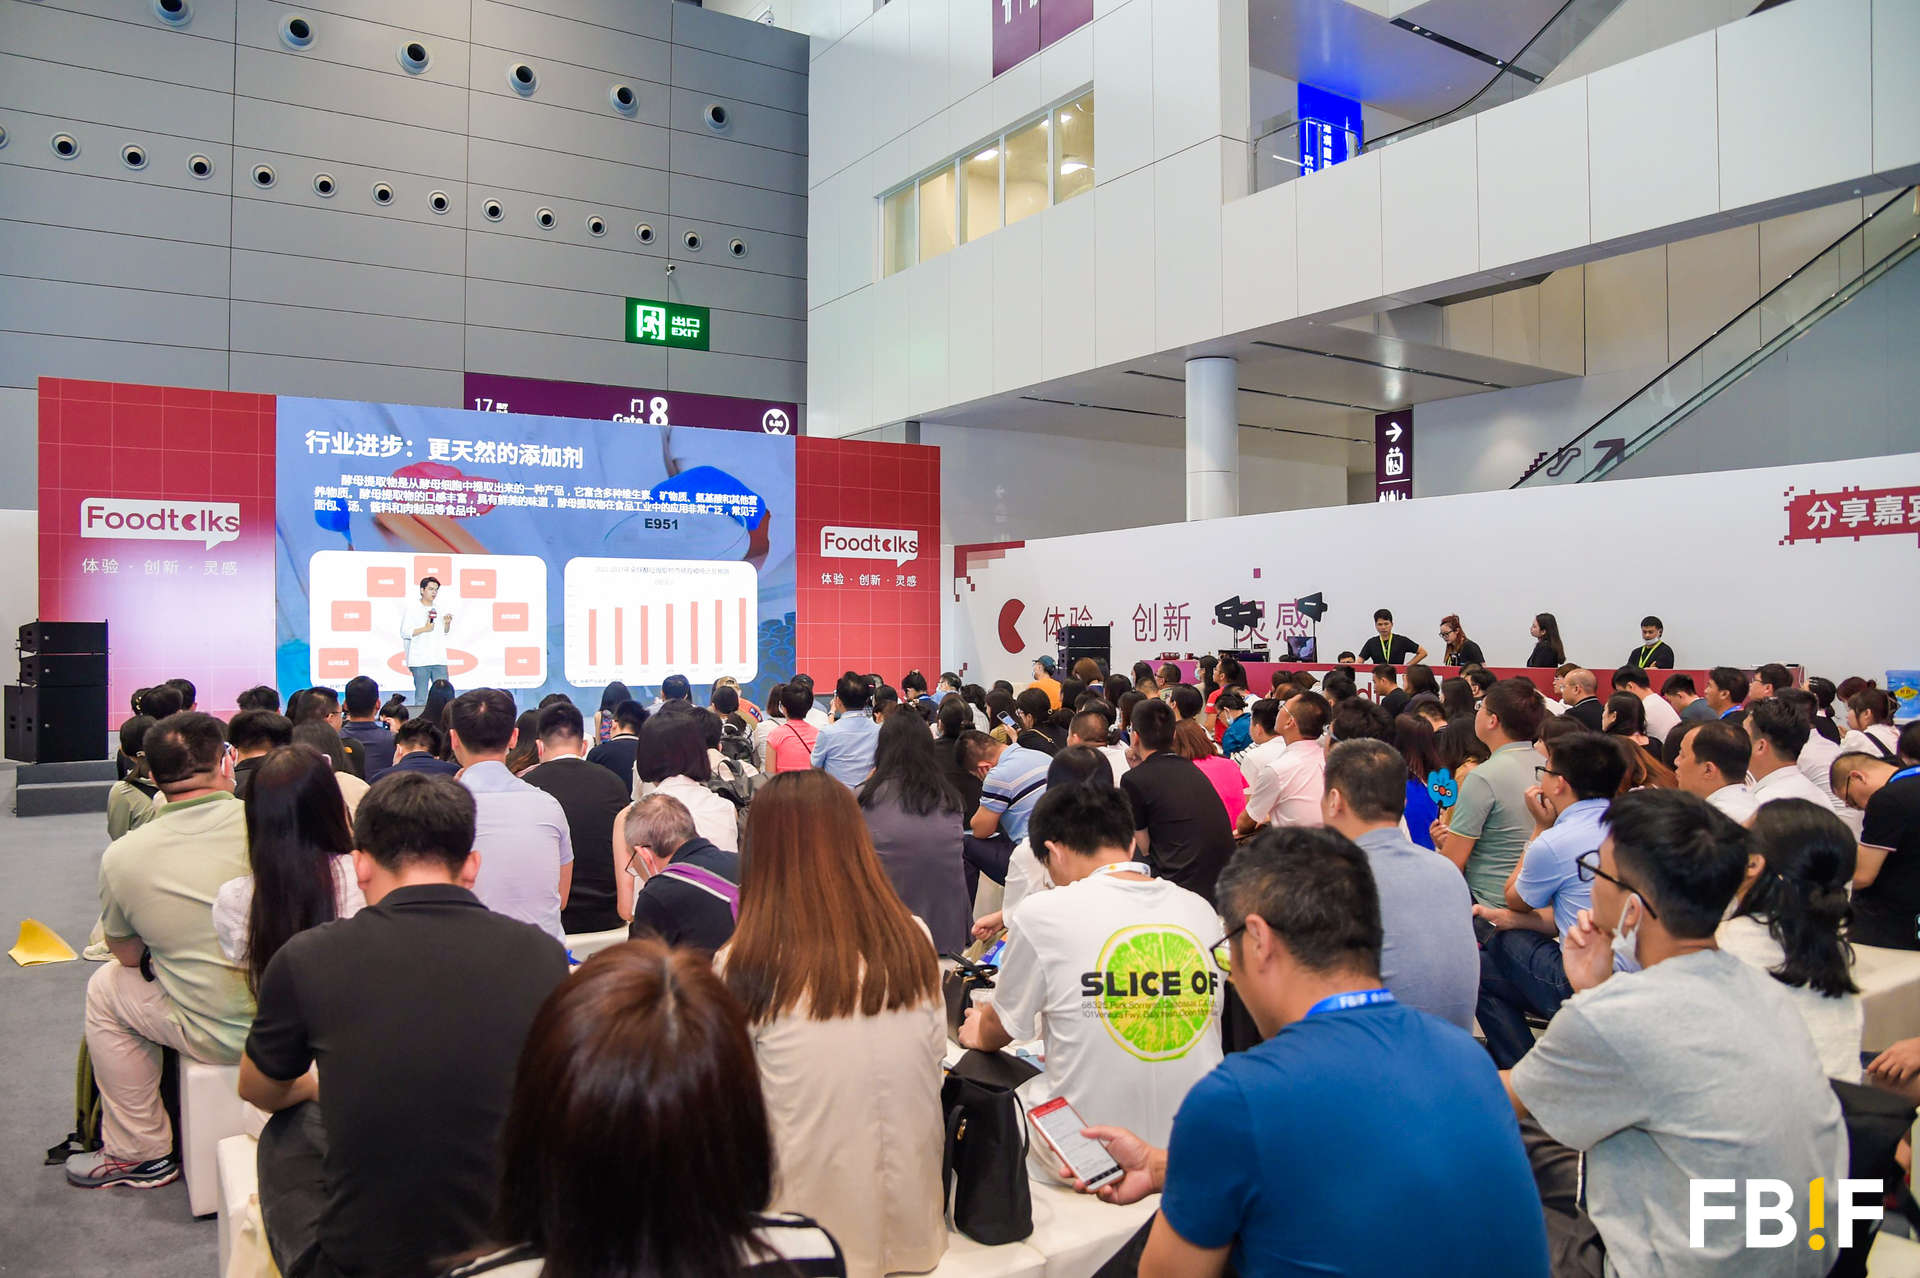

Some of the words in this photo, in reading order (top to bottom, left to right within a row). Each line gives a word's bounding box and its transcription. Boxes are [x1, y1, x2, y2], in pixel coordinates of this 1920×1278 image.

[672, 316, 700, 328] 出口
[671, 327, 700, 338] EXIT
[631, 398, 644, 413] 门
[649, 396, 669, 426] 8
[644, 518, 679, 530] E951
[1132, 602, 1191, 642] 创新
[1080, 971, 1181, 997] SLICE
